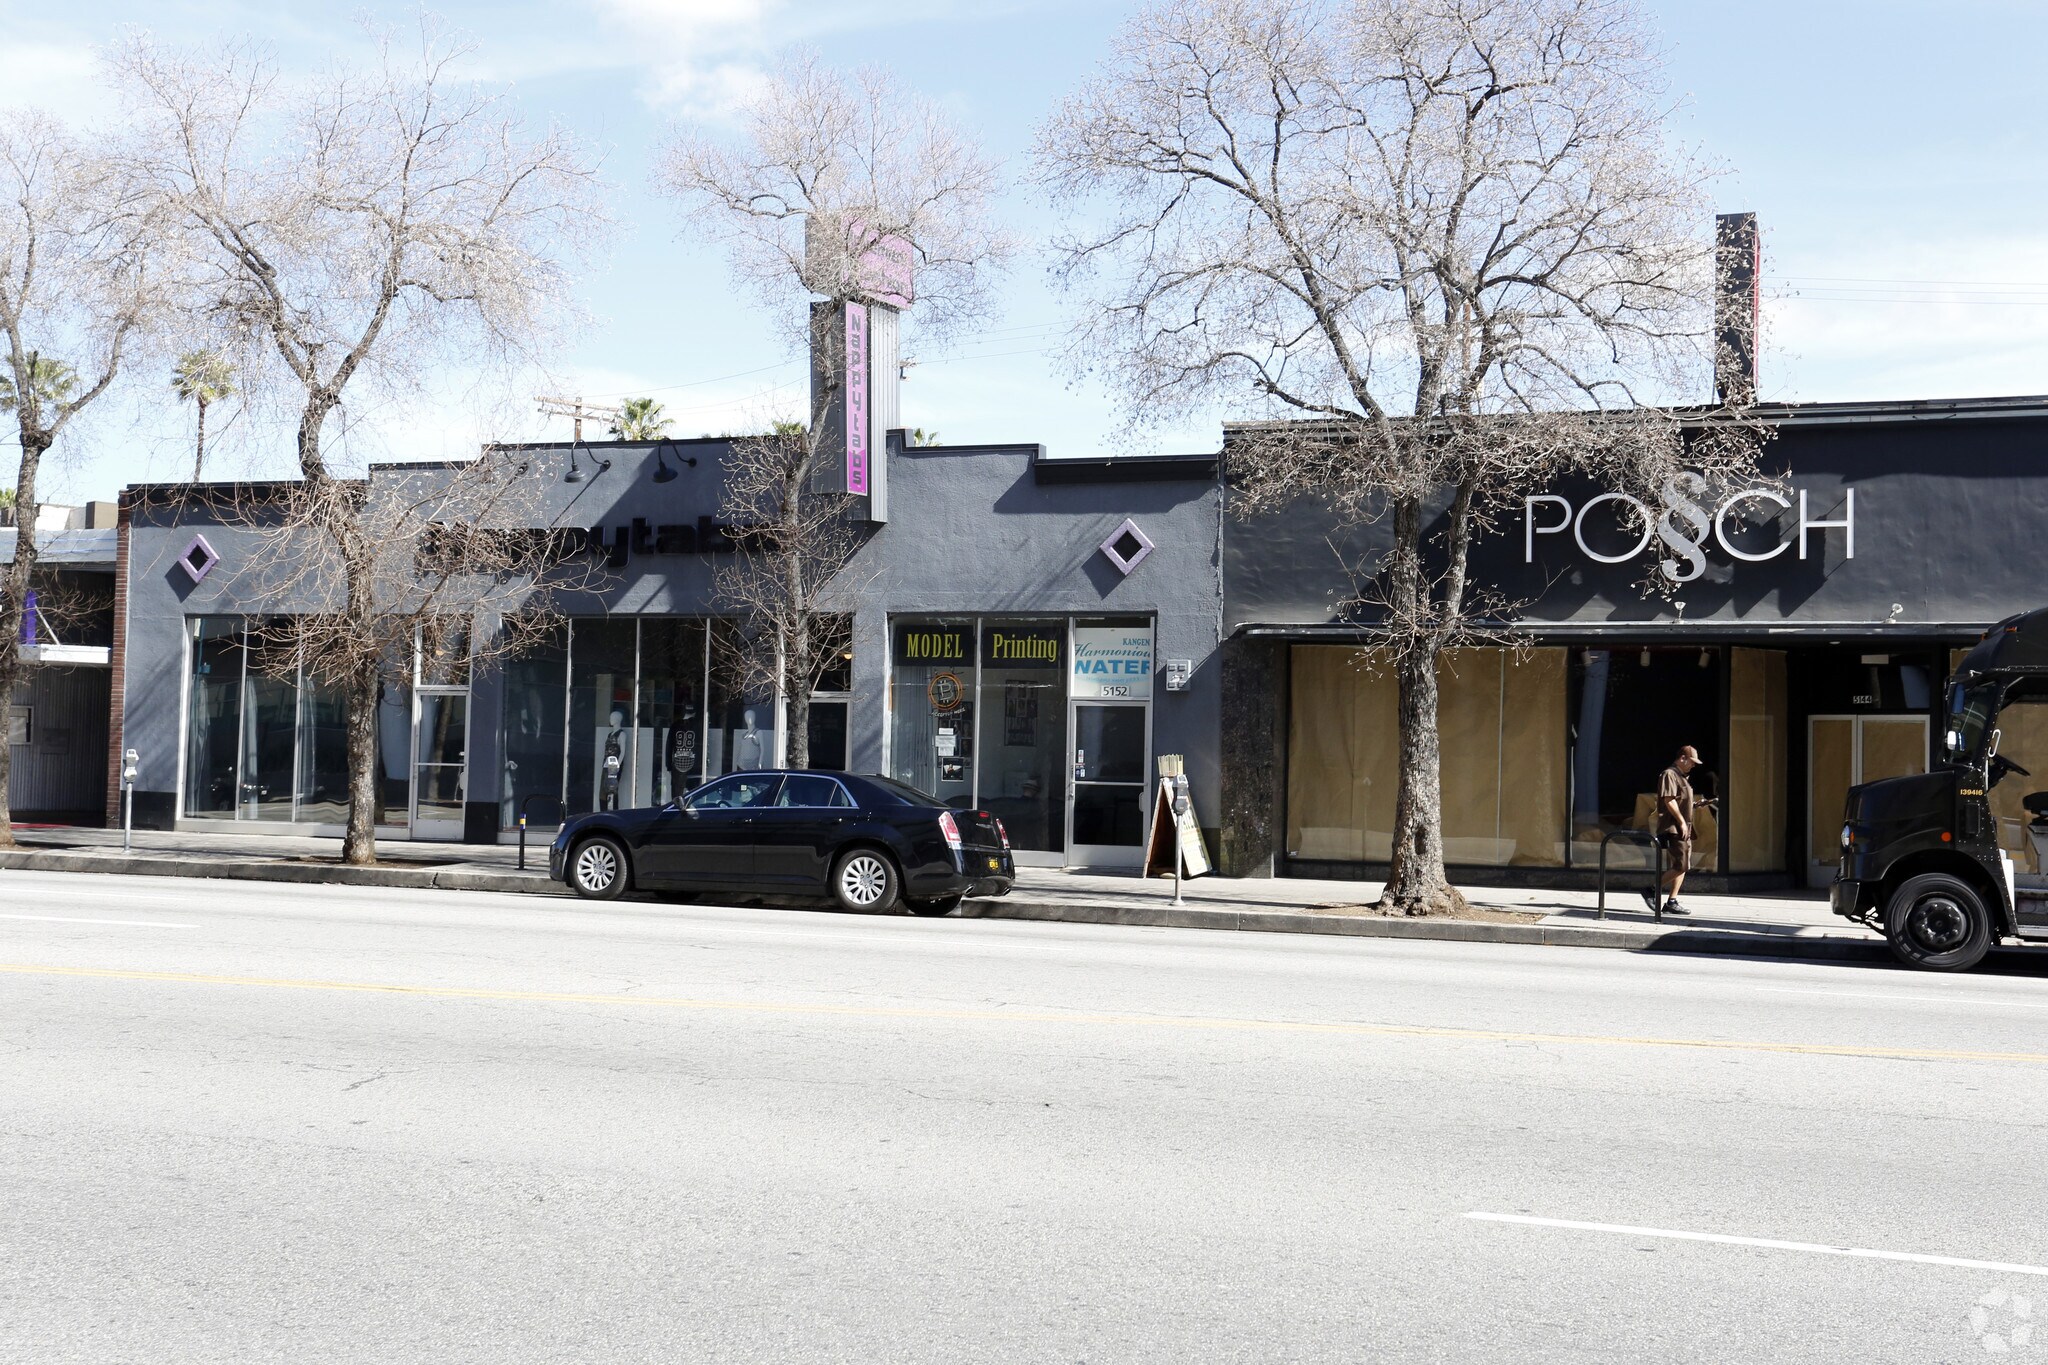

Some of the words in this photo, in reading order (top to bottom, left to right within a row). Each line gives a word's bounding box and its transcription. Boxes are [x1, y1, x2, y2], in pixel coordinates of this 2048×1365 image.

[906, 633, 963, 658] MODEL
[992, 634, 1058, 662] Printing
[1122, 637, 1150, 647] KANGEN
[1103, 686, 1127, 697] 5152
[676, 731, 695, 748] 98
